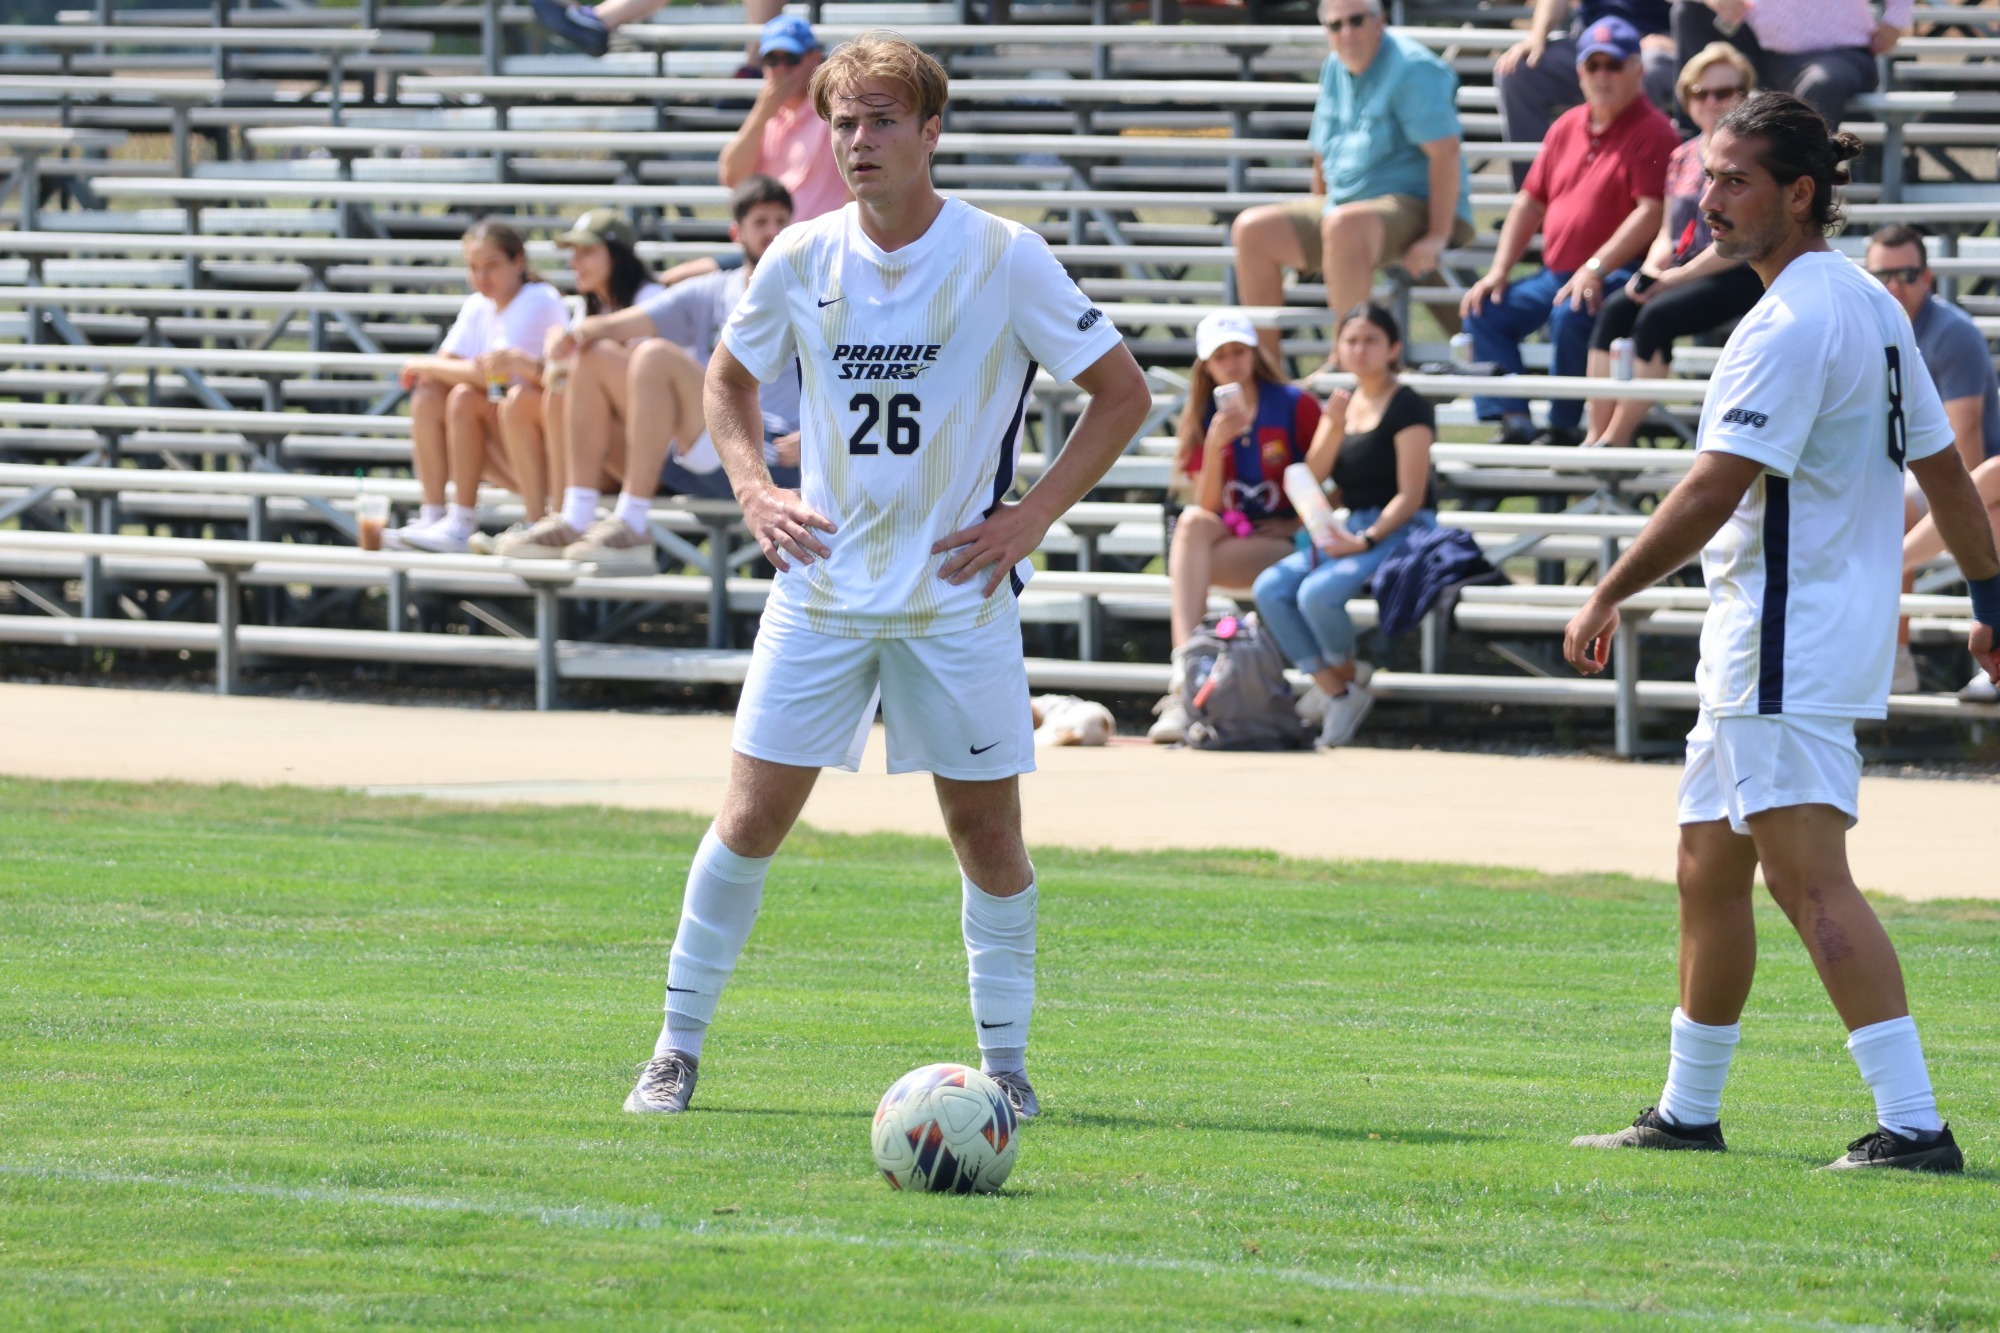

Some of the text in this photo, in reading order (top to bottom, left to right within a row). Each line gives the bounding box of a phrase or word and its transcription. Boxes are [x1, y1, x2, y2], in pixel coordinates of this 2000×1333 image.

[833, 344, 942, 361] PRAIRIE
[837, 363, 921, 380] STARS
[849, 393, 922, 455] 26
[1884, 345, 1906, 473] 8
